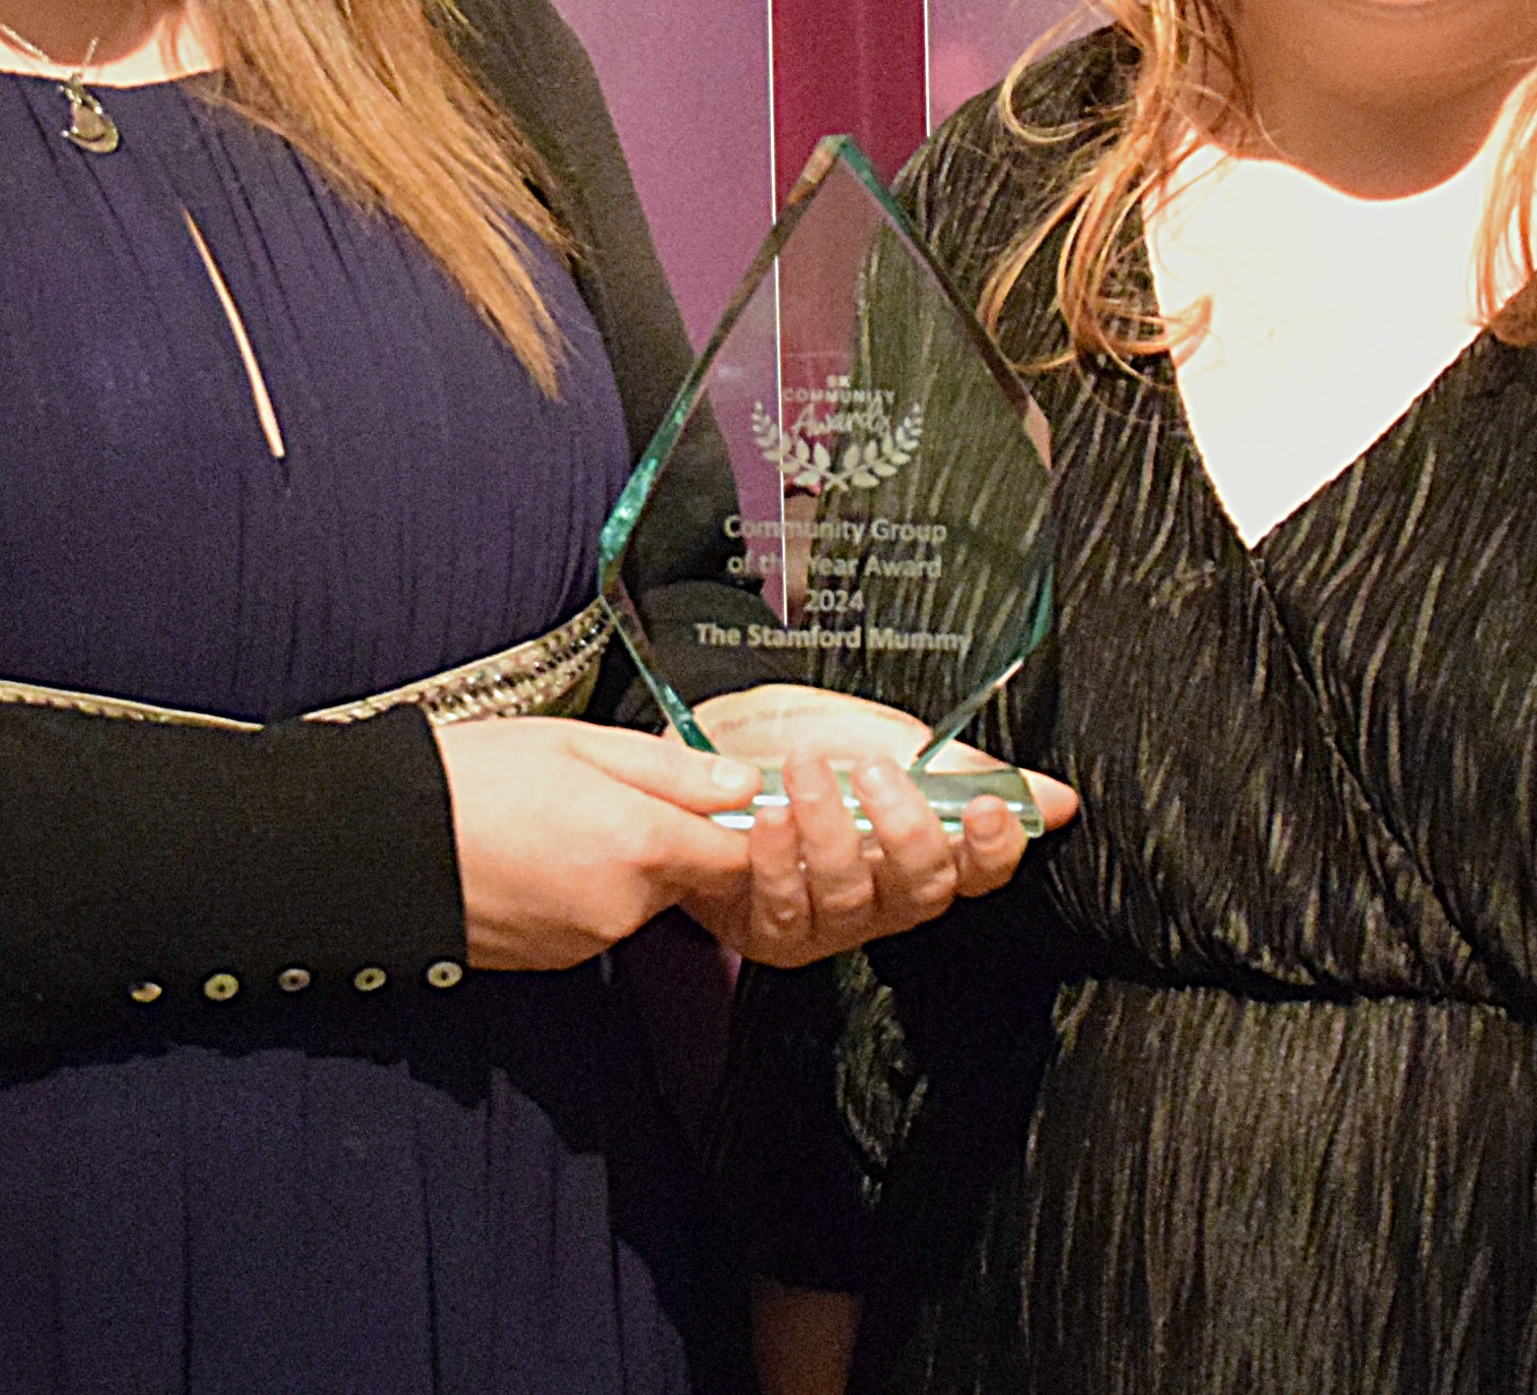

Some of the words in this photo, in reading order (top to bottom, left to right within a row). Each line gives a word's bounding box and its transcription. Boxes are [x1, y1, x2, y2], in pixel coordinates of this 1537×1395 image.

[783, 387, 895, 404] COMMUNITY
[723, 514, 864, 545] Community
[870, 517, 948, 544] Group
[727, 550, 754, 575] of
[805, 552, 859, 577] Year
[864, 554, 943, 578] Award
[803, 588, 864, 613] 2024
[694, 621, 742, 646] The
[746, 623, 862, 649] Stamford
[867, 626, 970, 658] Mummy
